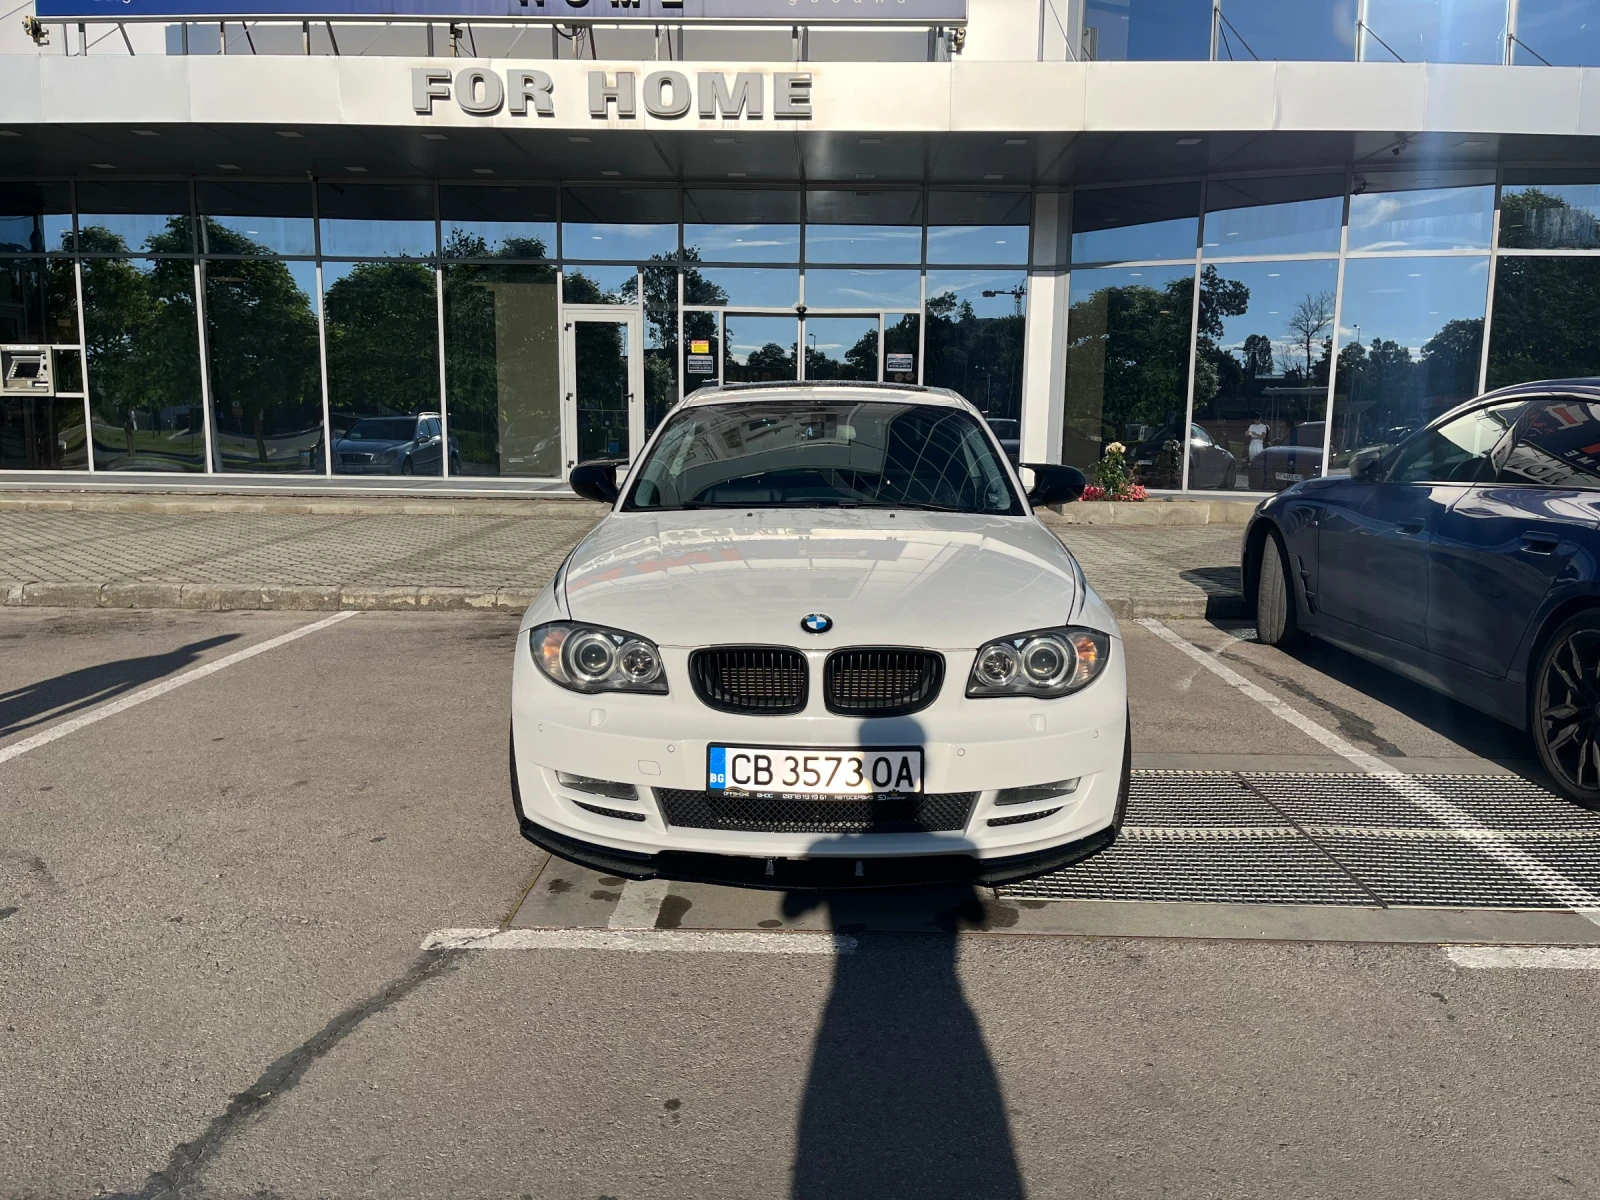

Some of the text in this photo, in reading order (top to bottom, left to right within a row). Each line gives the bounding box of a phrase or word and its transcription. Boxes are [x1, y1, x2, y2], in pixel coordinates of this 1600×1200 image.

[411, 68, 813, 120] FOR HOME
[710, 773, 725, 784] BG
[731, 753, 774, 786] CB
[782, 755, 864, 788] 3573
